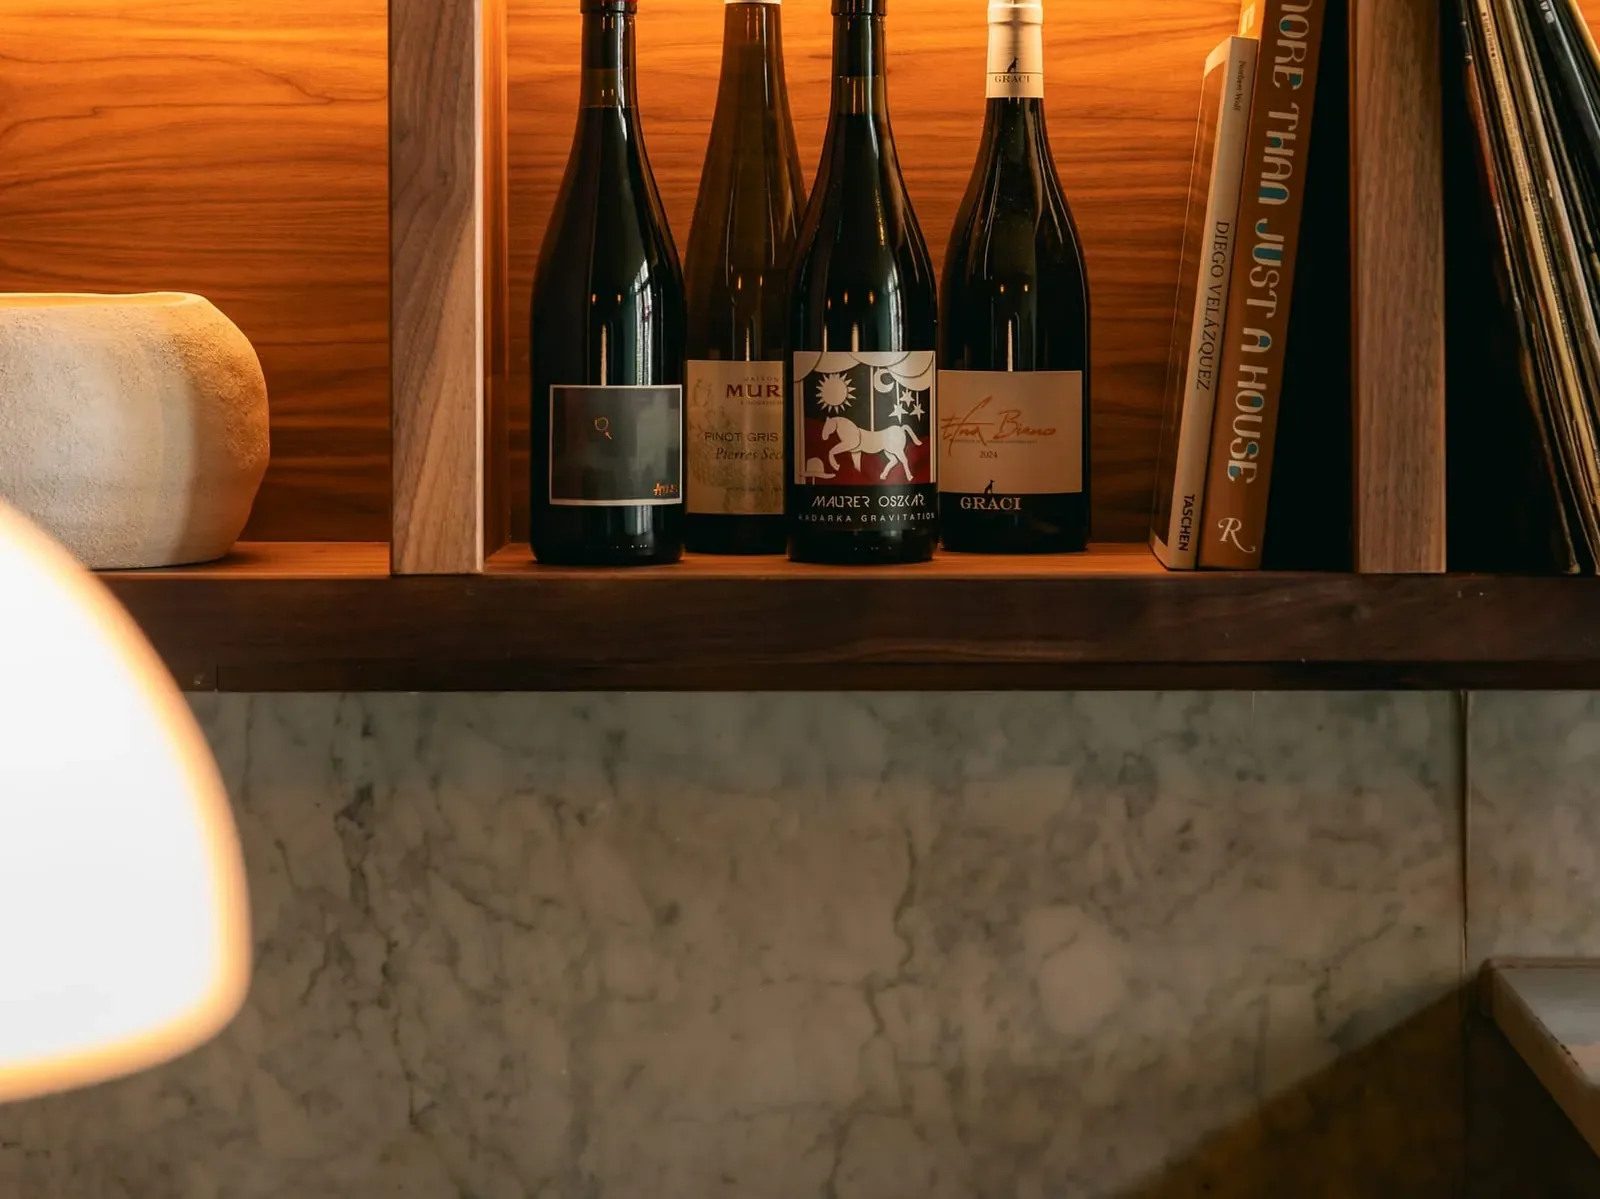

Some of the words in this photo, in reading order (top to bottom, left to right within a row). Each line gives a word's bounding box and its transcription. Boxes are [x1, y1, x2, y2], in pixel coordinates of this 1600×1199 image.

[994, 75, 1030, 83] GRACI
[1258, 102, 1299, 205] THAN
[1210, 221, 1230, 278] DIEGO
[1246, 218, 1285, 319] JUST
[1196, 285, 1222, 391] VELÁZQUEZ
[1240, 327, 1272, 352] A
[725, 384, 781, 398] MUR
[704, 432, 742, 442] PINOT
[747, 432, 779, 442] GRIS
[993, 409, 1056, 439] Bianco
[1227, 364, 1268, 484] HOUSE
[812, 495, 870, 508] MAURER
[960, 497, 1022, 510] GRACI
[1178, 494, 1195, 551] TASCHEN
[1217, 517, 1256, 554] R
